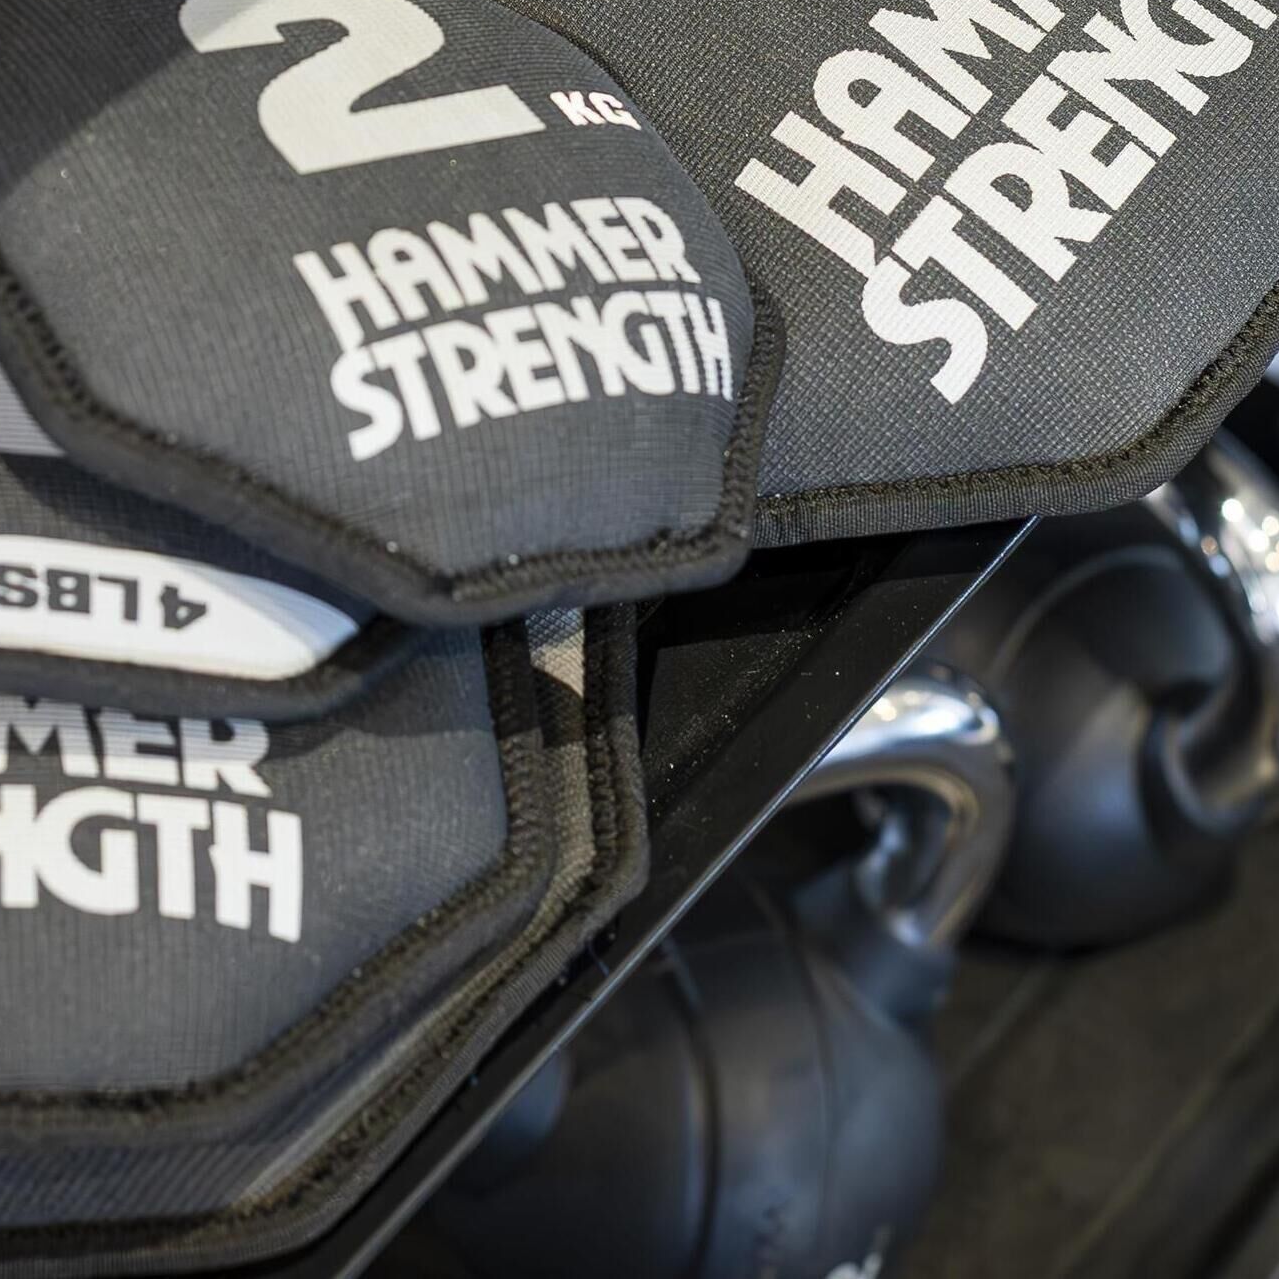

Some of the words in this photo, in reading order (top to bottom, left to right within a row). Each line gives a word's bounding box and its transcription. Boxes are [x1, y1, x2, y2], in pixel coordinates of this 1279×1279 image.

[550, 90, 642, 130] KG
[293, 196, 702, 352] HAMMER
[330, 290, 733, 462] STRENGTH
[160, 585, 207, 630] 4
